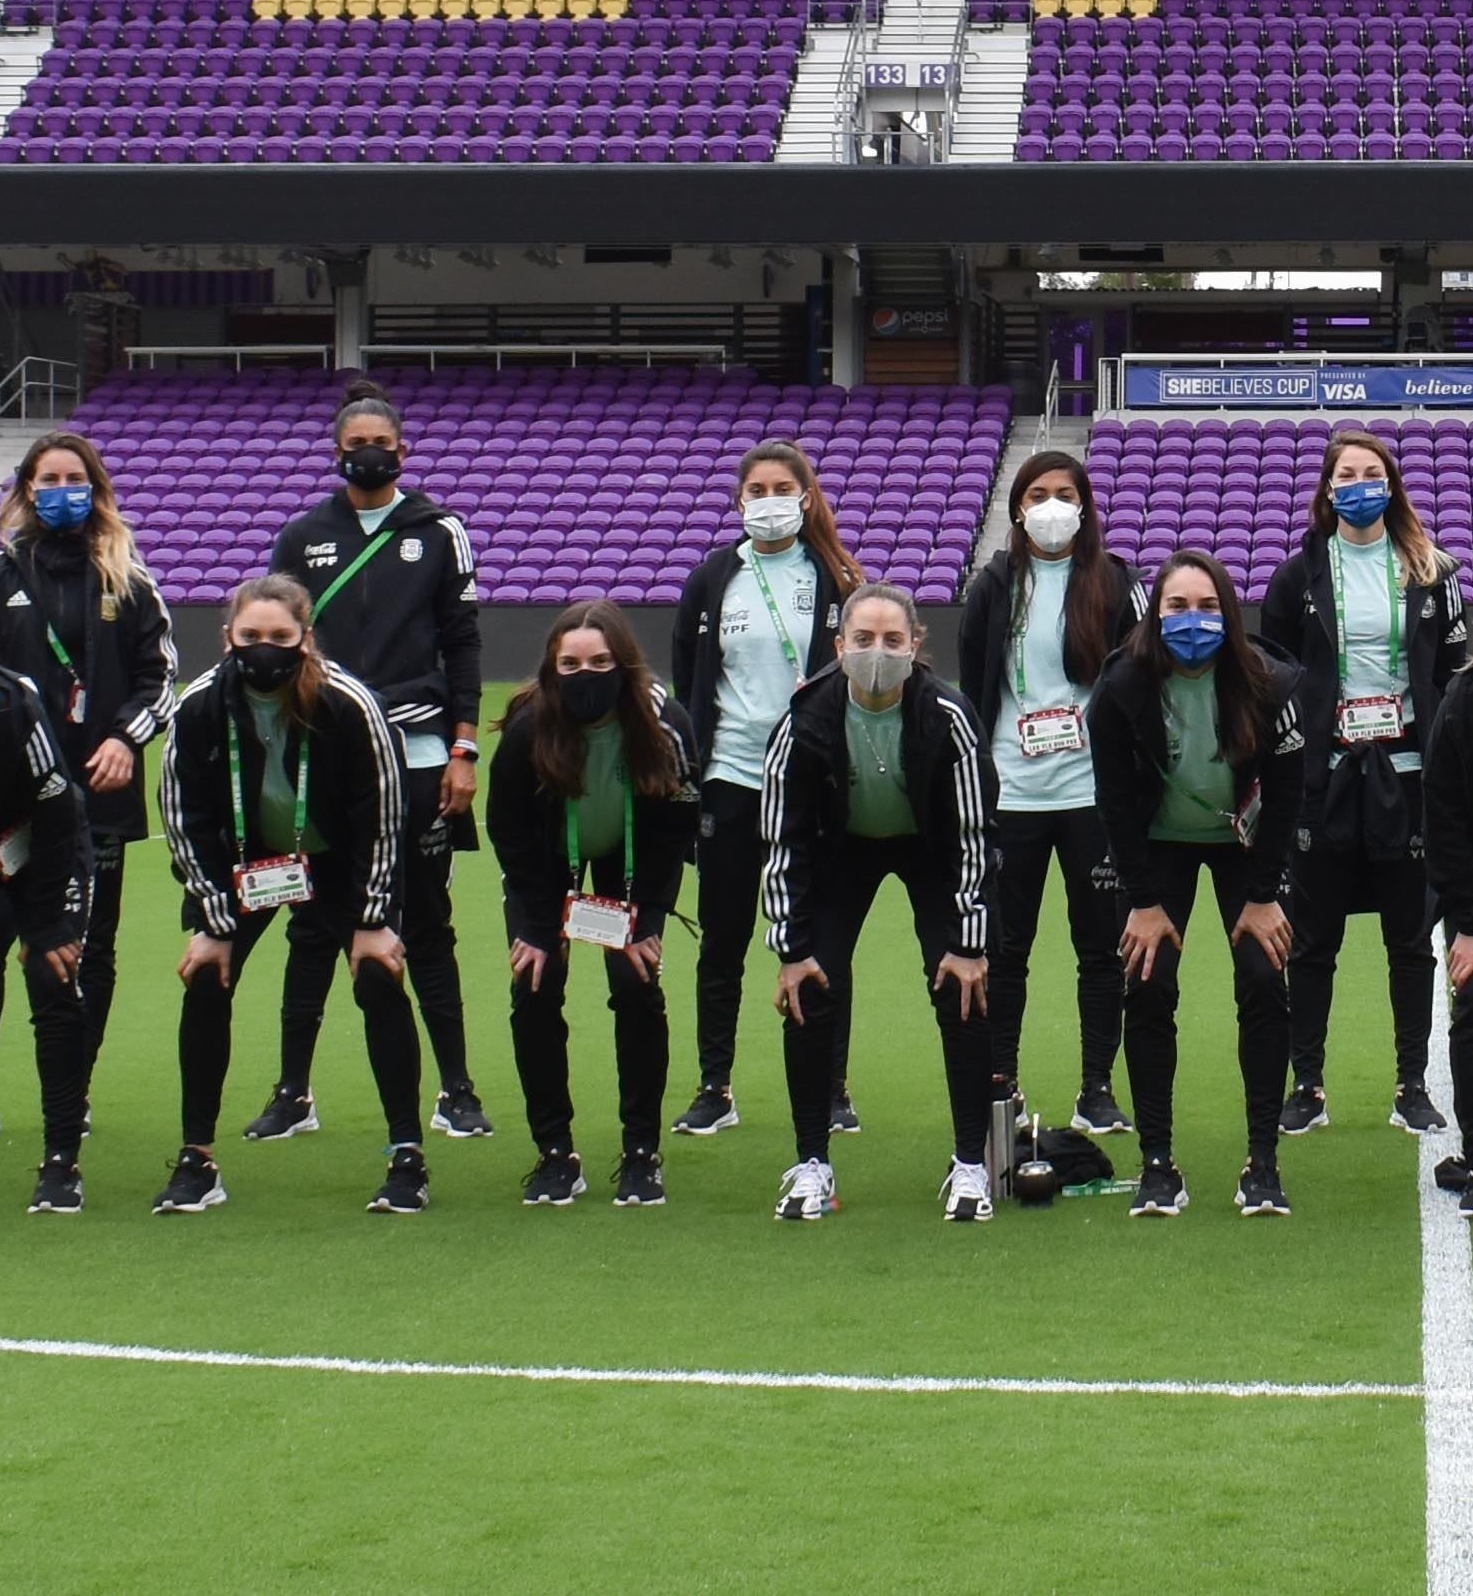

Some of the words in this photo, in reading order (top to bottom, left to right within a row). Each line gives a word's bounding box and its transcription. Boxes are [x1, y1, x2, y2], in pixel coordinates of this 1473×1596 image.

[867, 65, 904, 84] 133
[902, 307, 948, 325] pepsi
[1167, 378, 1273, 395] SHEBELIEVES
[1277, 378, 1310, 395] CUP
[1323, 383, 1367, 401] VISA
[1404, 378, 1473, 396] believe
[306, 556, 338, 569] YPF
[721, 624, 751, 635] YPF
